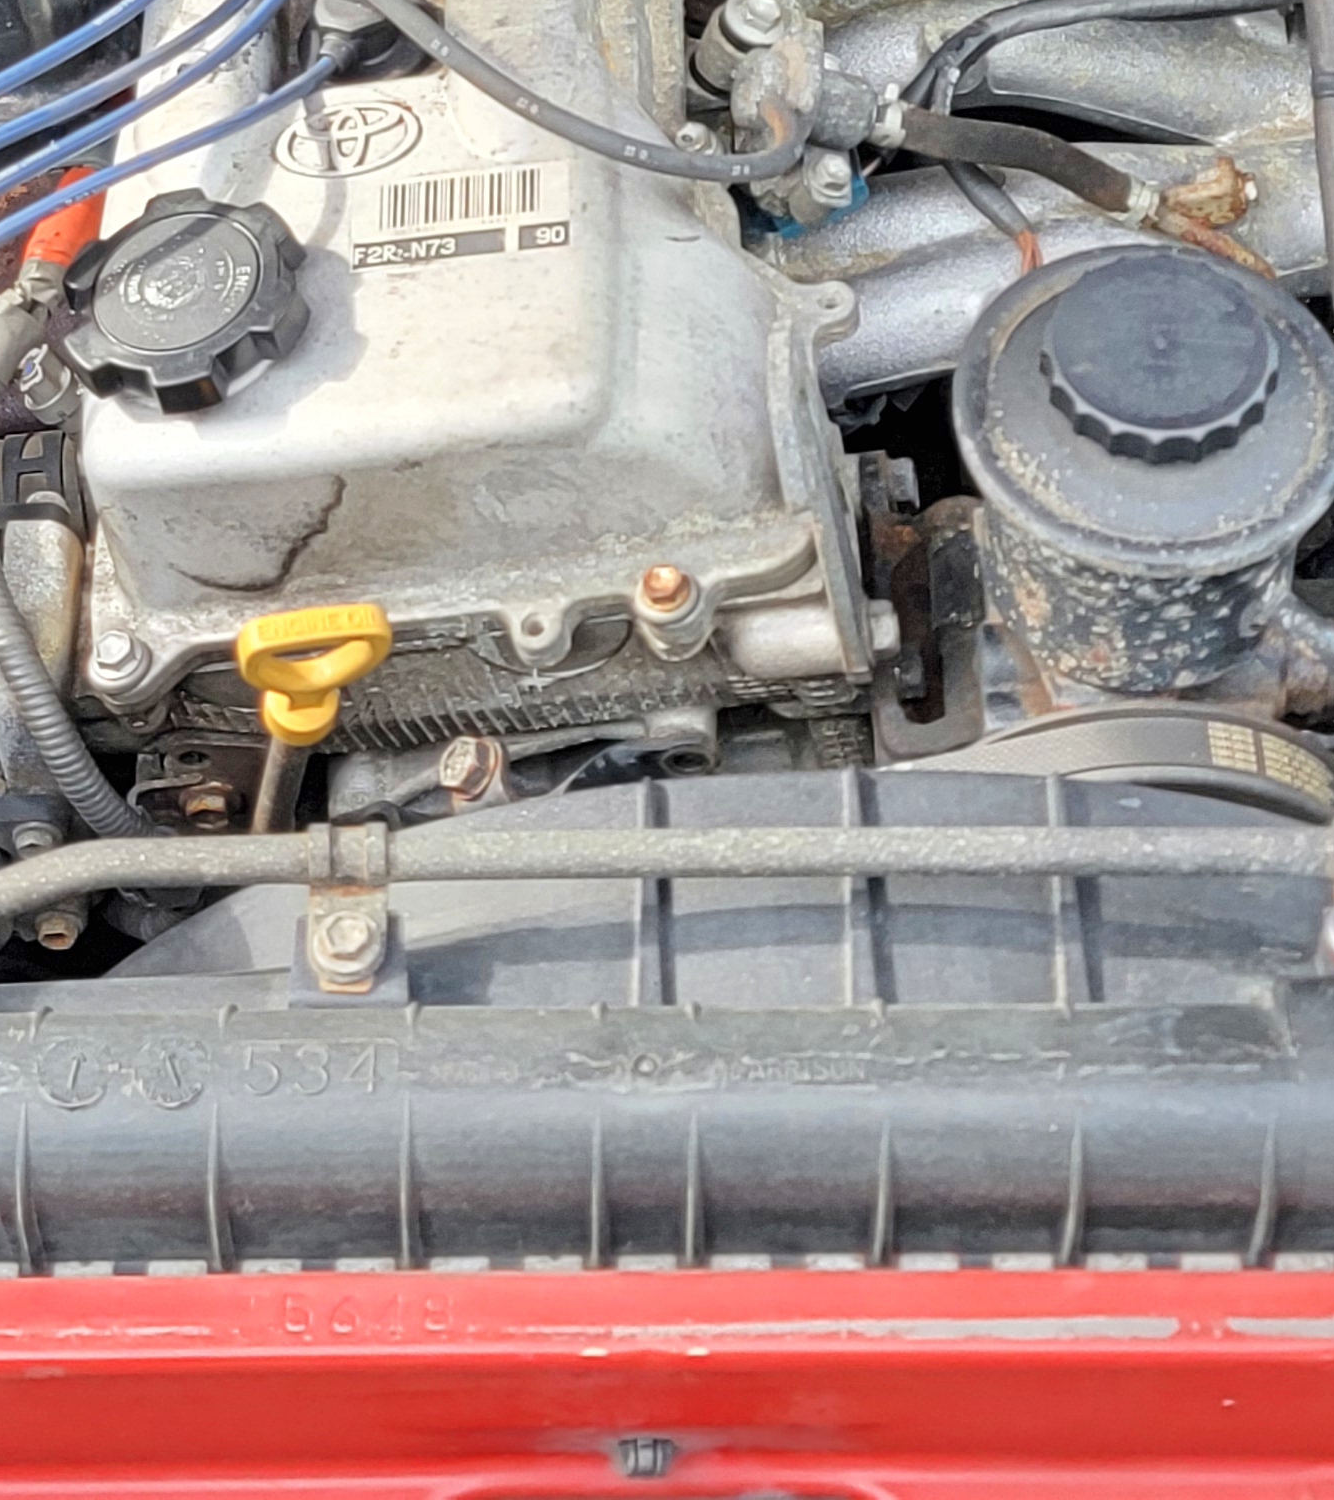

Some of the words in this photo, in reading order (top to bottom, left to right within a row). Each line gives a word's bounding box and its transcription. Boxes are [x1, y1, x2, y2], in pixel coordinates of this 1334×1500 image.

[536, 226, 566, 245] 90
[257, 610, 342, 641] ENGINE
[243, 1044, 399, 1095] 534
